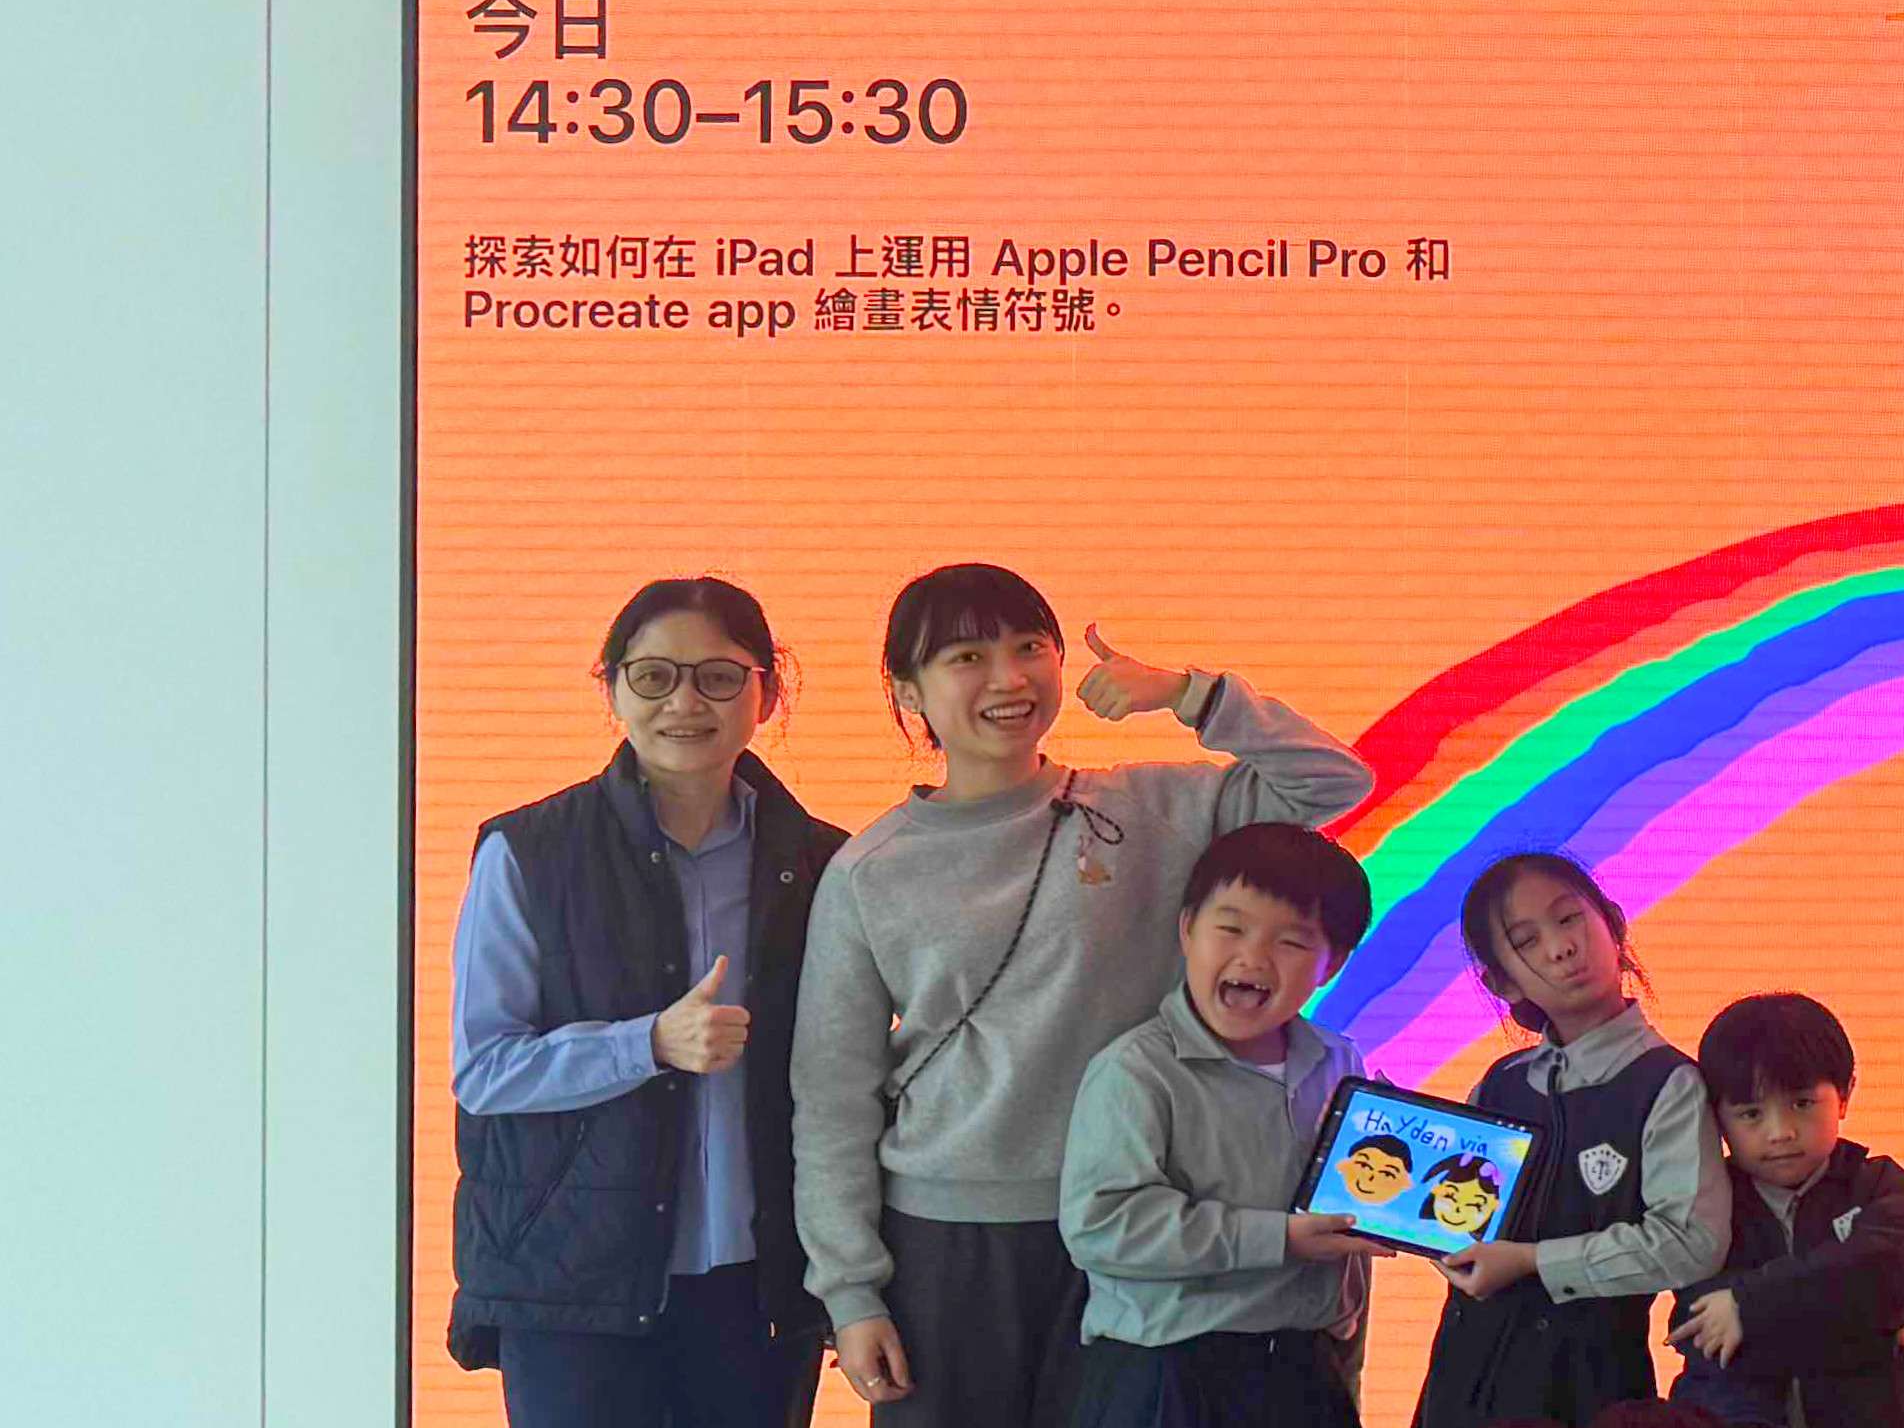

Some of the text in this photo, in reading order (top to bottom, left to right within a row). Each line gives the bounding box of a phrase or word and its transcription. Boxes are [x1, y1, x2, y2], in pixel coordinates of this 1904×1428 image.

[465, 234, 1449, 286] 探索如何在 iPad 上運用 Apple Pencil Pro 和
[465, 289, 1120, 338] Procreate app 繪畫表情符號。
